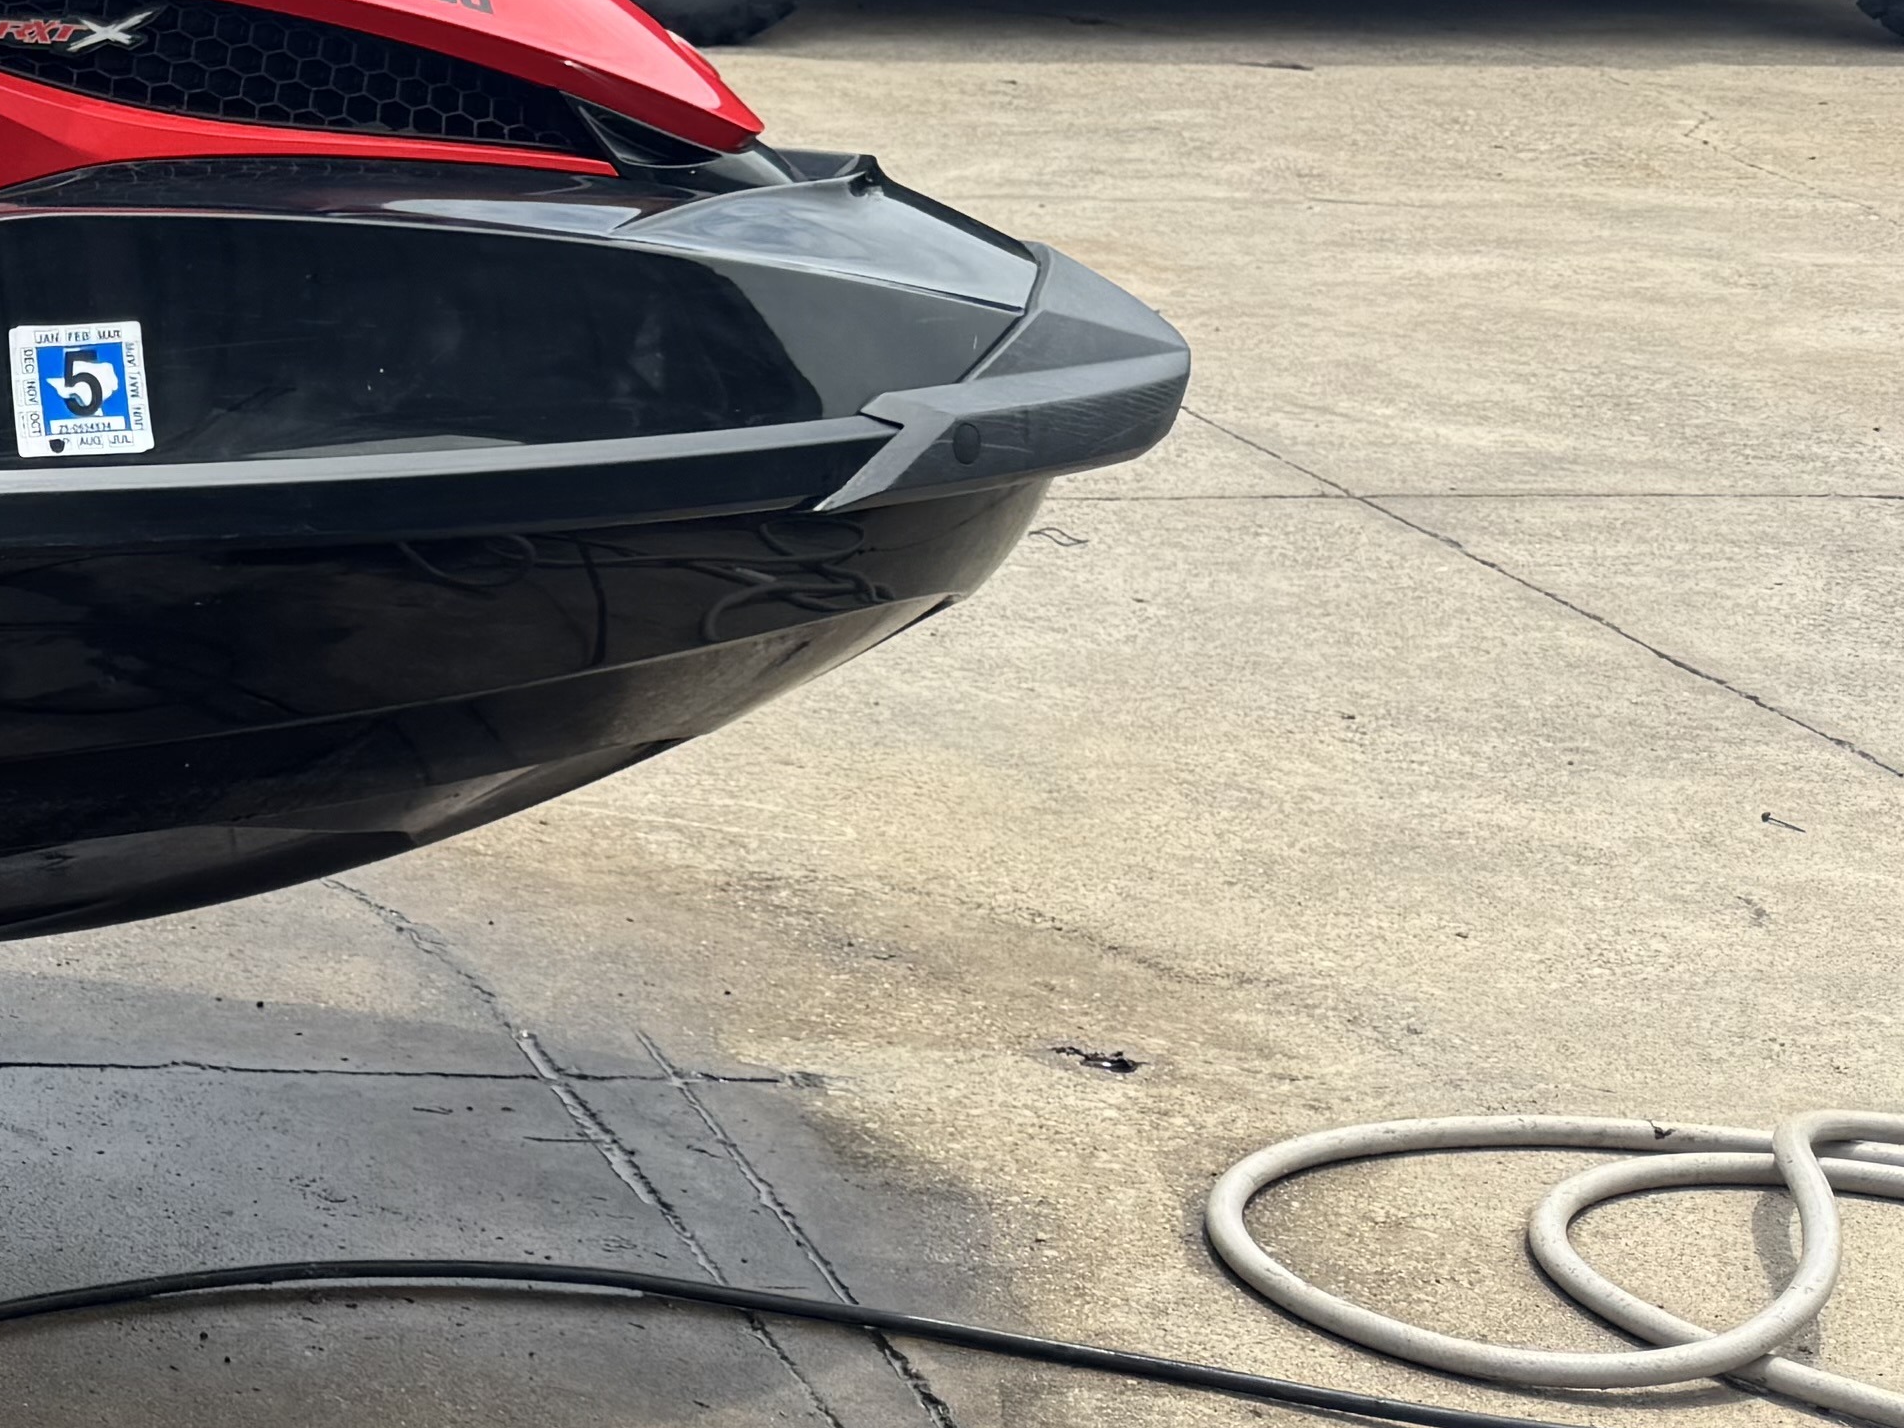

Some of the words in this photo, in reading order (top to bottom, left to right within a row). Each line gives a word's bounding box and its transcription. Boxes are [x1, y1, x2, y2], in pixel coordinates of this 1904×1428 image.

[37, 332, 59, 344] JAN
[68, 332, 89, 342] FEB
[23, 349, 35, 373] DEC
[26, 380, 38, 405] NOV
[64, 349, 103, 416] 5
[30, 412, 43, 436] OCT
[79, 436, 101, 446] AUG
